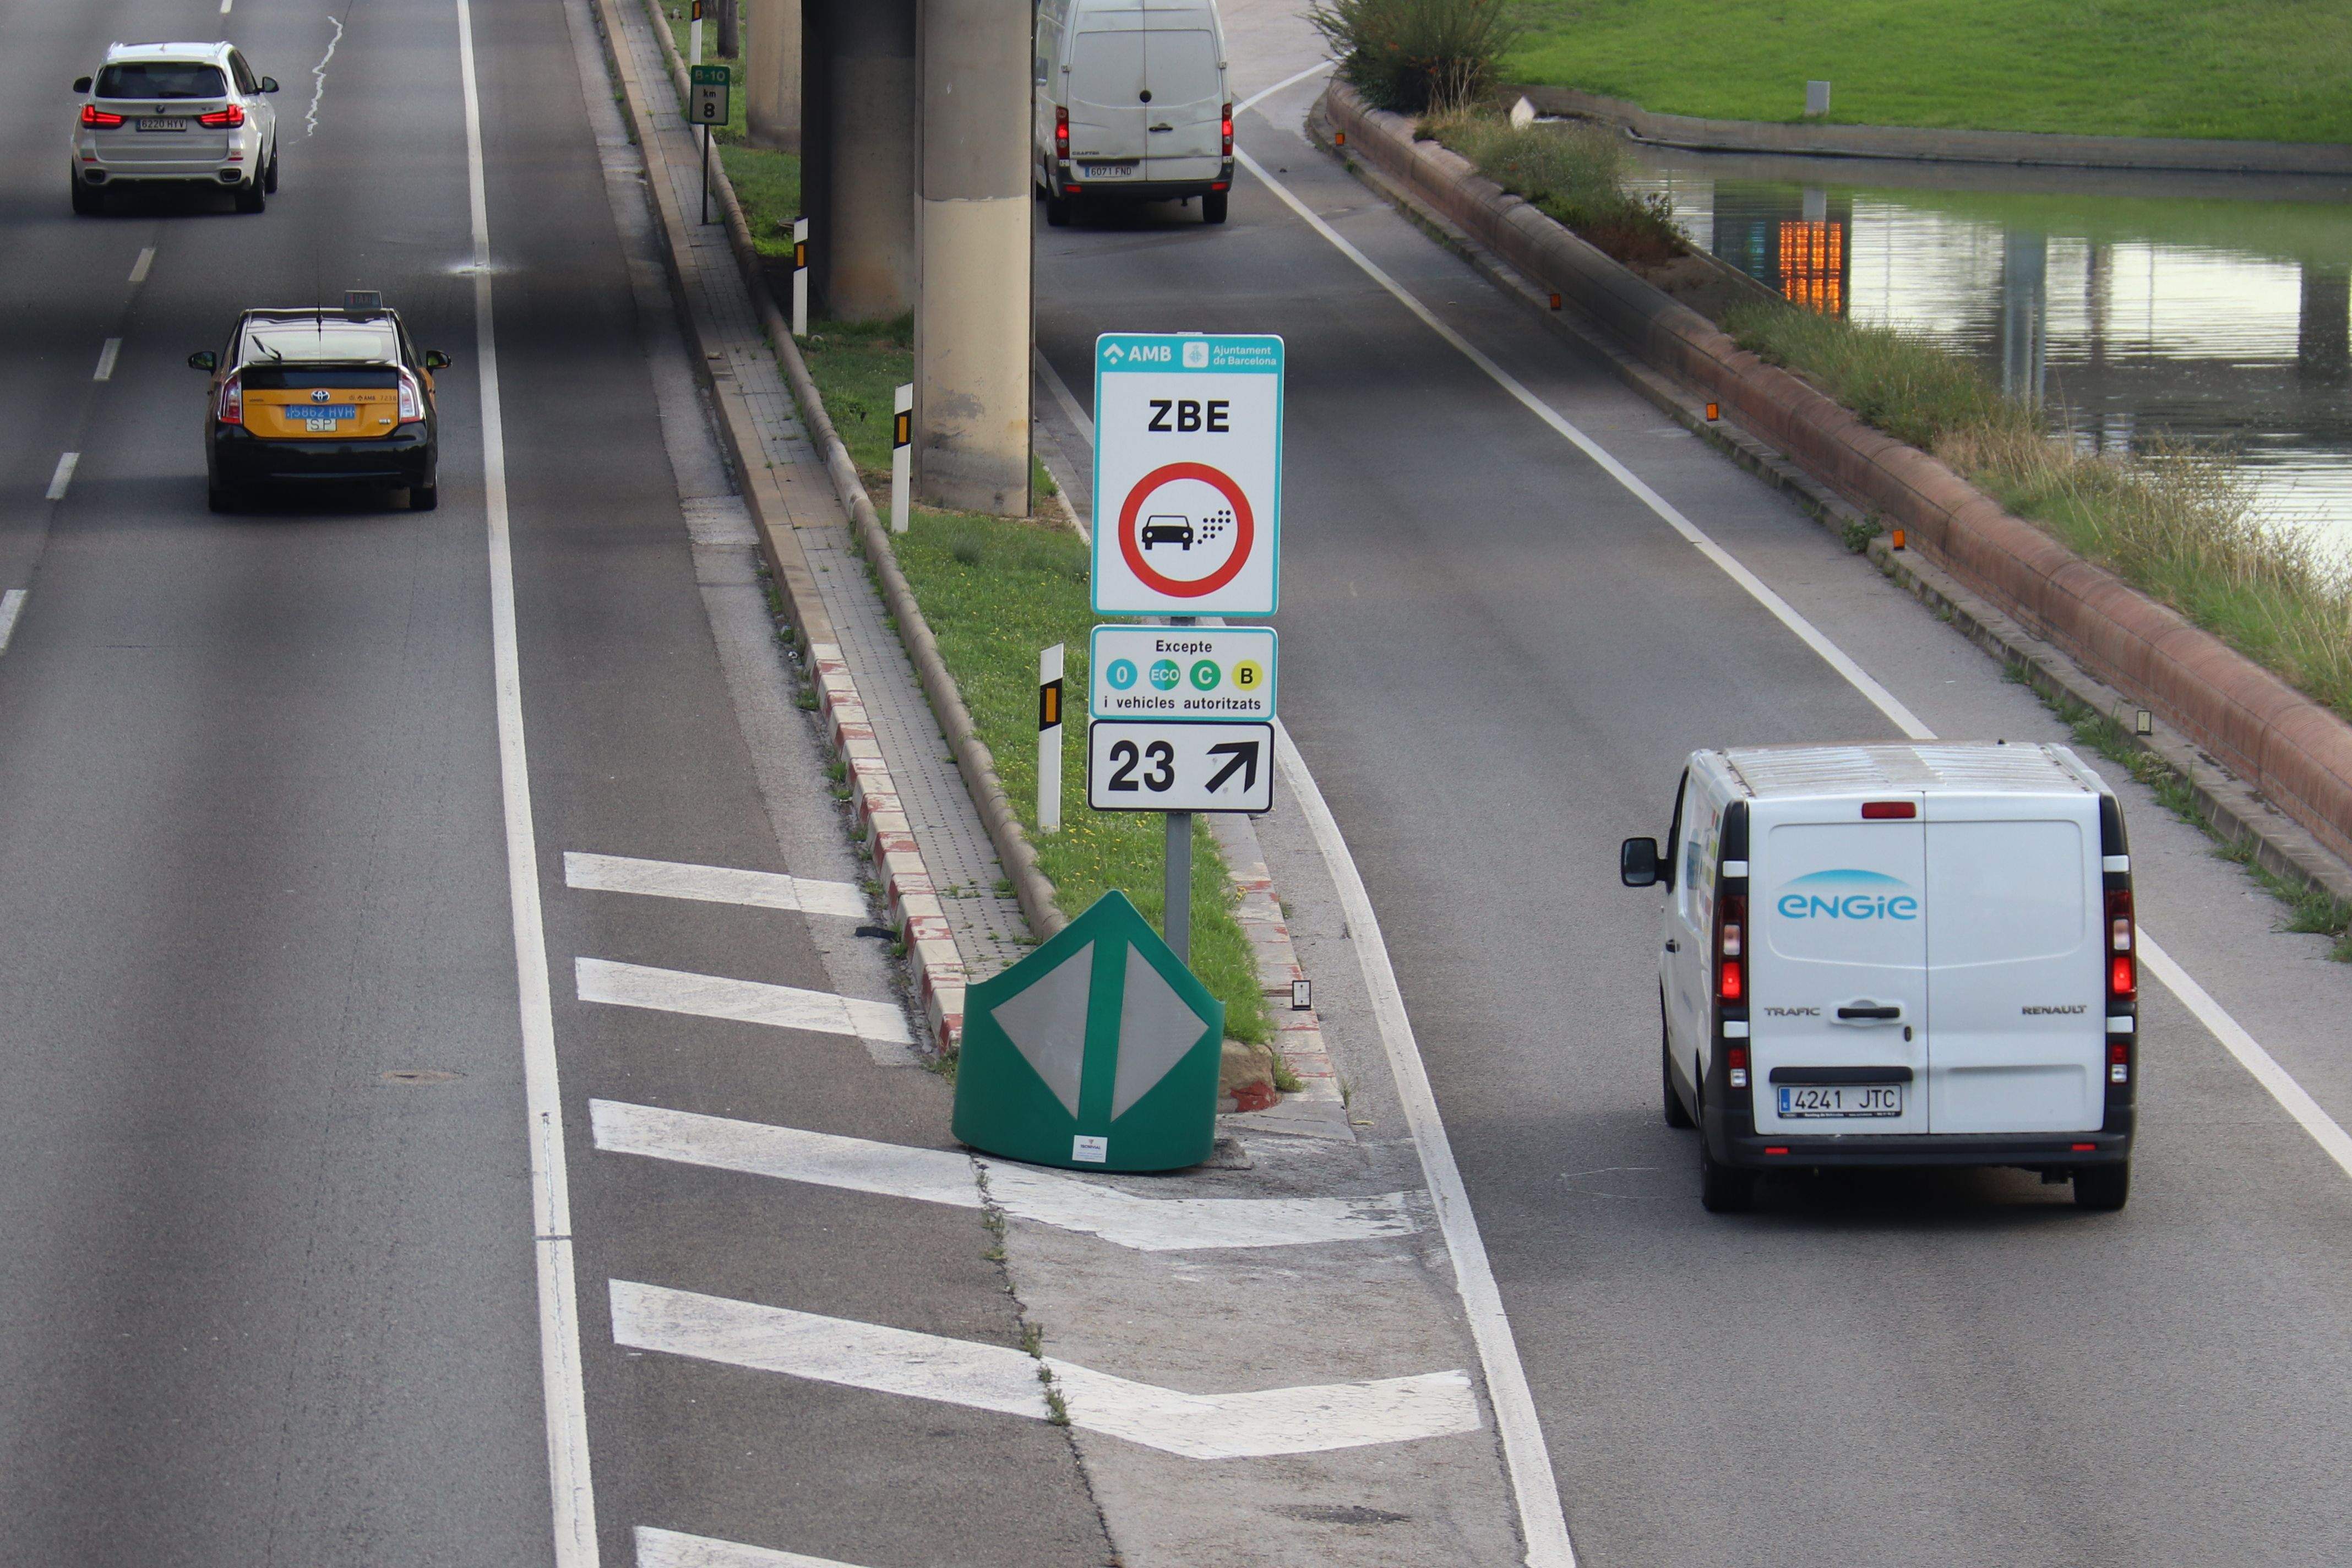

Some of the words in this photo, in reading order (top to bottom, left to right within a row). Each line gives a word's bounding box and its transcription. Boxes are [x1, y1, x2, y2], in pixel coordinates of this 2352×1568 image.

[695, 70, 725, 81] B-10
[703, 89, 716, 97] km
[704, 102, 715, 118] 8
[1115, 167, 1131, 175] FND
[1129, 346, 1172, 362] AMB
[1213, 345, 1271, 356] Ajuntament
[1228, 356, 1277, 365] Barcelona
[293, 407, 324, 417] 5862
[329, 407, 352, 417] HVH
[1148, 400, 1229, 432] ZBE
[1156, 640, 1212, 655] Excepte
[1151, 669, 1179, 681] ECO
[1198, 667, 1212, 684] C
[1241, 668, 1253, 684] B
[1104, 696, 1108, 708] i
[1117, 696, 1175, 709] vehicles
[1184, 698, 1261, 710] autoritzats
[1108, 740, 1175, 792] 23
[1763, 1007, 1820, 1016] TRAFIC
[2022, 1005, 2087, 1015] RENAULT
[1795, 1090, 1841, 1109] 4241
[1859, 1090, 1894, 1108] JTC
